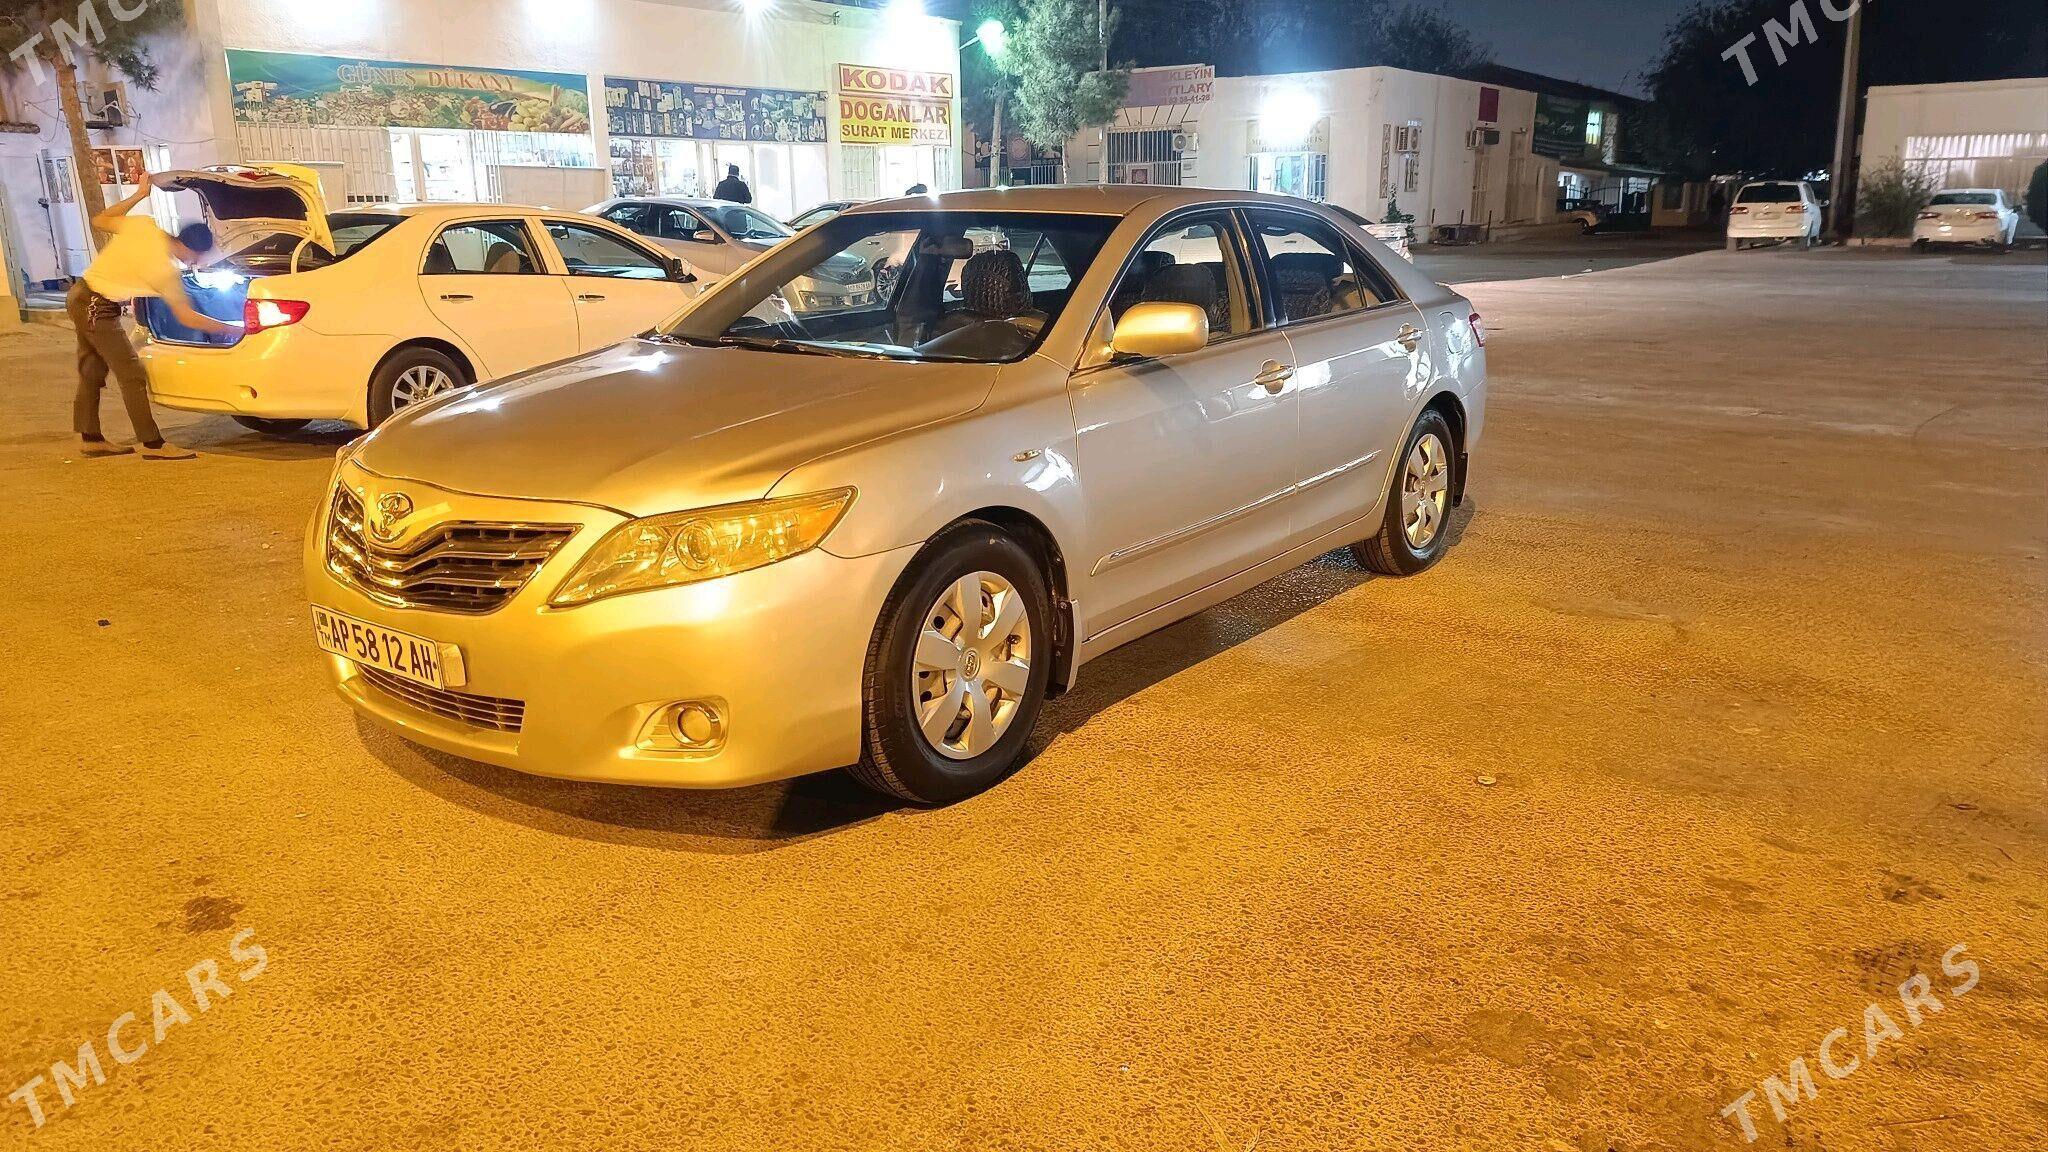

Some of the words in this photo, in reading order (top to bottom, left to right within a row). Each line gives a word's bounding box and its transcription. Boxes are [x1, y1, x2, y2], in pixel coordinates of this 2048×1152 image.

[842, 68, 949, 94] KODAK
[841, 101, 949, 124] DOGANLAR
[842, 124, 887, 138] SURAT
[891, 126, 949, 141] MERKEZI
[330, 616, 349, 653] AP
[409, 640, 435, 683] AH
